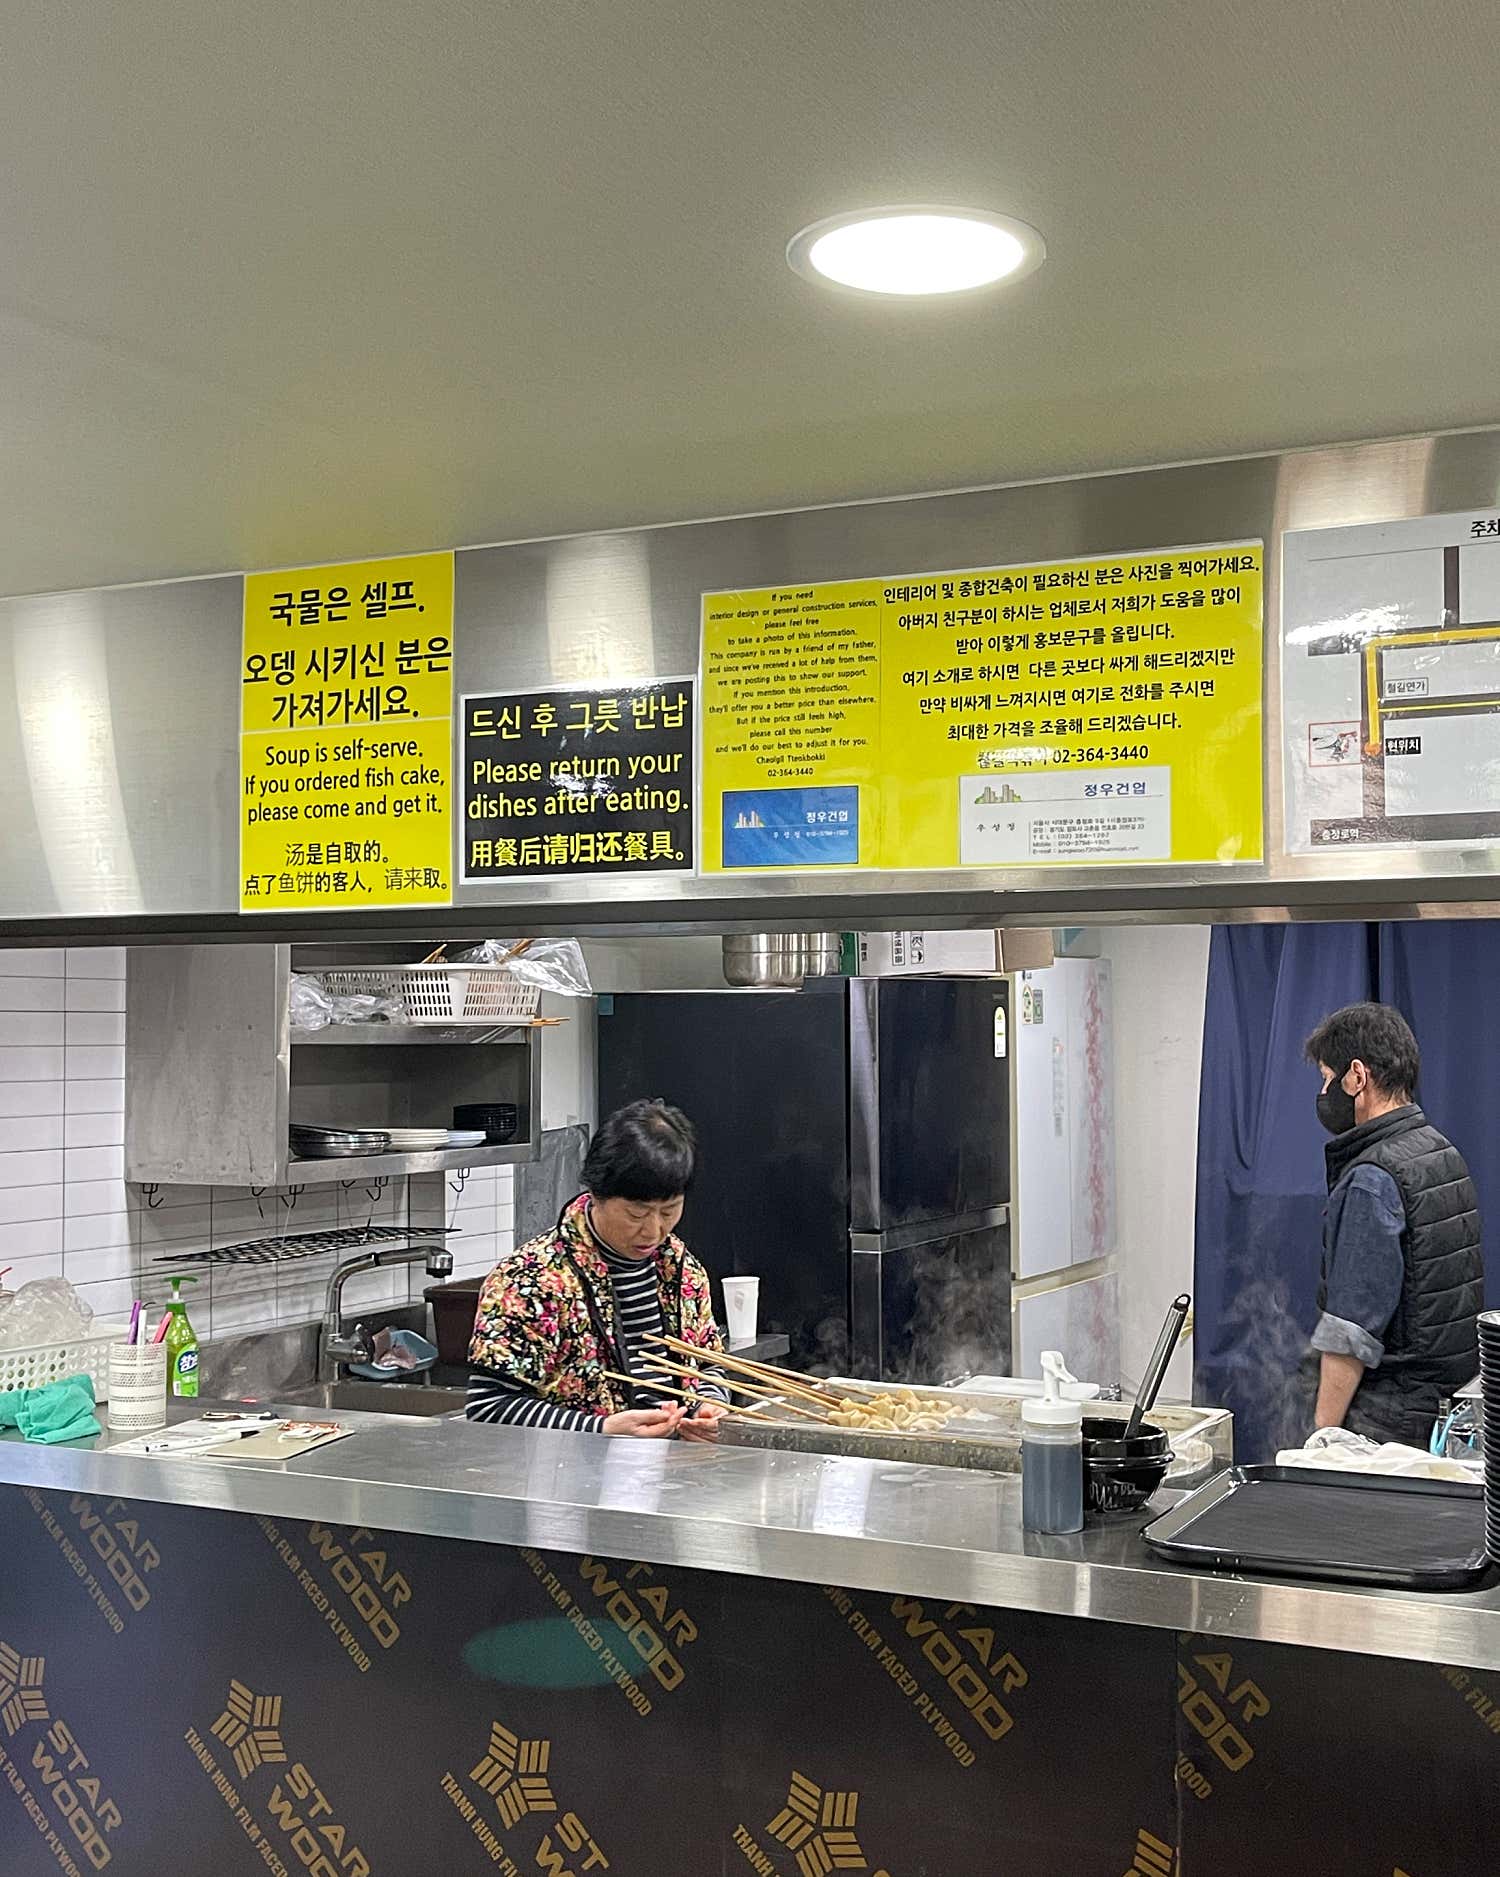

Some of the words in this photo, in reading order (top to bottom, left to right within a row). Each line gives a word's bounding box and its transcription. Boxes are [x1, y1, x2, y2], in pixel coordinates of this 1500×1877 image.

[780, 592, 792, 602] you
[796, 590, 814, 599] need
[884, 584, 936, 604] 인테리어
[942, 582, 954, 599] 및
[958, 576, 1028, 597] 종합건축이
[1033, 570, 1089, 590] 필요하신
[1095, 568, 1124, 585] 분은
[1128, 562, 1174, 582] 사진을
[1178, 556, 1260, 577] 찍어가세요.
[270, 586, 350, 627] 국물은
[360, 580, 425, 619] 셀프.
[737, 610, 758, 620] design
[774, 606, 799, 616] general
[802, 602, 845, 612] construction
[898, 612, 938, 631] 아버지
[943, 608, 997, 627] 친구분이
[1002, 605, 1044, 622] 하시는
[1050, 600, 1106, 618] 업체로서
[1112, 594, 1156, 614] 저희가
[1160, 590, 1206, 608] 도움을
[1212, 586, 1240, 606] 많이
[764, 620, 786, 630] please
[806, 618, 819, 626] free
[764, 634, 784, 643] photo
[956, 637, 983, 654] 받아
[988, 634, 1029, 652] 이렇게
[1034, 628, 1106, 649] 홍보문구를
[1111, 623, 1174, 642] 올립니다.
[243, 650, 296, 686] 오뎅
[305, 641, 385, 683] 시키신
[395, 636, 451, 676] 분은
[710, 652, 724, 660] This
[727, 650, 756, 660] company
[803, 644, 823, 652] friend
[902, 670, 928, 686] 여기
[933, 668, 974, 684] 소개로
[978, 664, 1019, 681] 하시면
[1029, 661, 1056, 678] 다른
[1062, 657, 1104, 676] 곳보다
[1110, 656, 1138, 672] 싸게
[1144, 648, 1235, 670] 해드리겠지만
[742, 691, 754, 699] you
[758, 688, 786, 696] mention
[745, 676, 770, 686] posting
[774, 674, 786, 682] this
[800, 672, 818, 680] show
[272, 685, 419, 728] 가져가세요.
[732, 704, 748, 712] offer
[751, 703, 764, 712] you
[798, 699, 814, 708] price
[920, 698, 946, 714] 만약
[951, 694, 991, 712] 비싸게
[996, 690, 1066, 708] 느껴지시면
[1072, 687, 1114, 704] 여기로
[1120, 683, 1164, 702] 전화를
[1170, 680, 1214, 698] 주시면
[470, 705, 521, 740] 드신
[530, 703, 558, 736] 후
[566, 699, 622, 733] 그릇
[632, 693, 688, 730] 반납
[750, 730, 771, 738] please
[804, 726, 832, 734] number
[774, 714, 790, 724] price
[794, 713, 805, 721] still
[809, 712, 824, 720] feels
[948, 724, 989, 740] 최대한
[994, 721, 1035, 738] 가격을
[1040, 718, 1082, 735] 조율해
[1088, 712, 1182, 732] 드리겠습니다.
[266, 745, 310, 767] Soup
[316, 742, 328, 762] is
[333, 738, 424, 761] self-serve.
[716, 745, 728, 753] and
[778, 742, 792, 750] best
[806, 740, 828, 748] adjust
[839, 738, 850, 746] for
[1053, 746, 1148, 763] 02-364-3440
[1388, 738, 1419, 751] 현위치
[245, 776, 256, 795] If
[260, 777, 289, 797] you
[294, 770, 359, 792] ordered
[365, 767, 394, 788] fish
[400, 765, 445, 787] cake,
[473, 758, 542, 785] Please
[550, 756, 620, 778] return
[628, 754, 682, 779] your
[768, 768, 814, 777] 02-364-3440
[468, 792, 536, 820] dishes
[544, 789, 596, 815] after
[606, 785, 688, 813] eating.
[1084, 782, 1146, 797] 정우건업
[248, 803, 299, 825] please
[304, 801, 350, 819] come
[355, 795, 387, 816] and
[392, 796, 420, 818] get
[425, 793, 443, 813] it.
[285, 840, 388, 866] 汤是自取的。
[471, 830, 684, 868] 用餐后请归还餐具。
[70, 1495, 151, 1613] WOOD
[41, 1509, 62, 1545] FILM
[60, 1538, 88, 1578] FACED
[86, 1573, 126, 1634] PLYWOOD
[308, 1522, 400, 1649] WOOD
[275, 1537, 300, 1573] FILM
[298, 1566, 329, 1613] FACED
[326, 1608, 372, 1674] PLYWOOD
[579, 1554, 686, 1692] WOOD
[542, 1570, 571, 1609] FILM
[567, 1604, 603, 1651] FACED
[600, 1648, 652, 1716] PLYWOOD
[890, 1596, 1014, 1741] WOOD
[848, 1610, 882, 1650] FILM
[876, 1644, 918, 1696] FACED
[914, 1692, 976, 1768] PLYWOOD
[48, 1720, 122, 1832] STAR
[184, 1726, 216, 1773] THANH
[212, 1768, 240, 1808] HUNG
[234, 1806, 262, 1842] FILM
[2, 1761, 26, 1794] FILM
[22, 1791, 48, 1832] FACED
[32, 1740, 112, 1870] WOOD
[440, 1772, 474, 1822] THANH
[472, 1816, 506, 1861] HUNG
[732, 1824, 774, 1877] THANH
